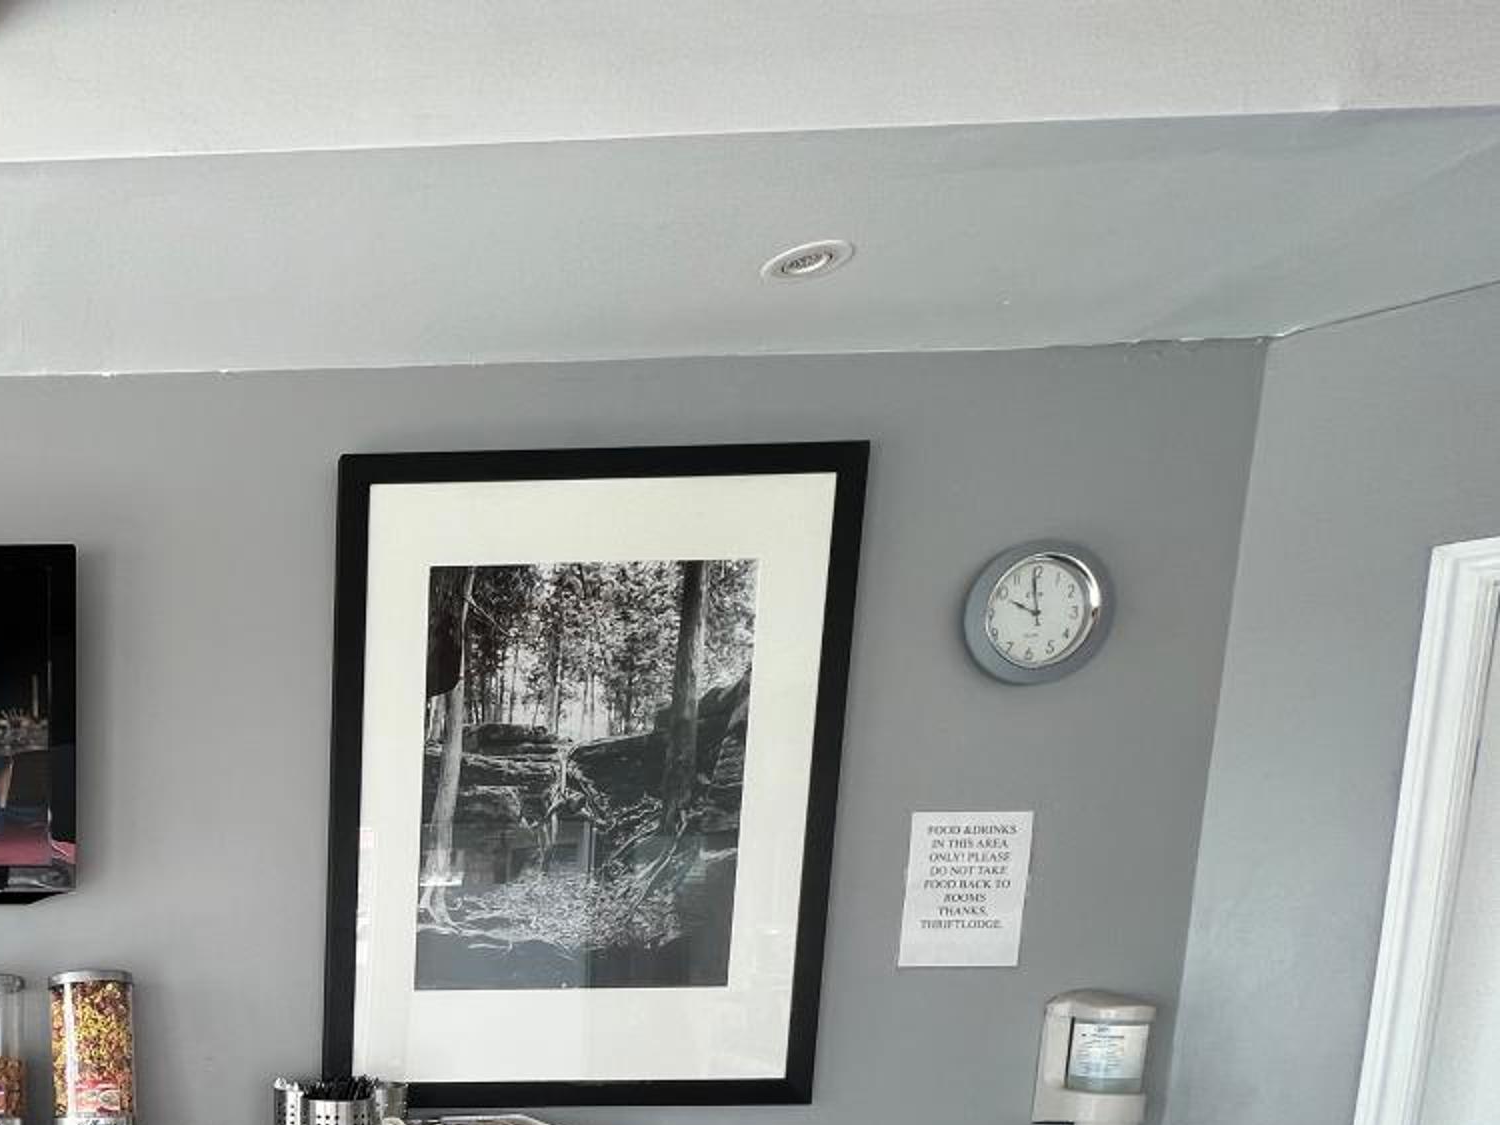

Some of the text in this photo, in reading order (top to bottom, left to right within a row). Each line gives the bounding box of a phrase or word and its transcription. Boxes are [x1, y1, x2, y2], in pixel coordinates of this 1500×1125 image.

[1068, 583, 1075, 598] 2
[1069, 605, 1078, 620] 3
[1045, 639, 1055, 654] 5
[1024, 646, 1034, 660] 6
[927, 825, 961, 835] FOOD
[931, 839, 1010, 849] IN THIS AREA
[967, 851, 1011, 862] PLEASE
[930, 865, 1009, 876] DO NOT TAKE
[923, 879, 1011, 889] FOOD BACK TO
